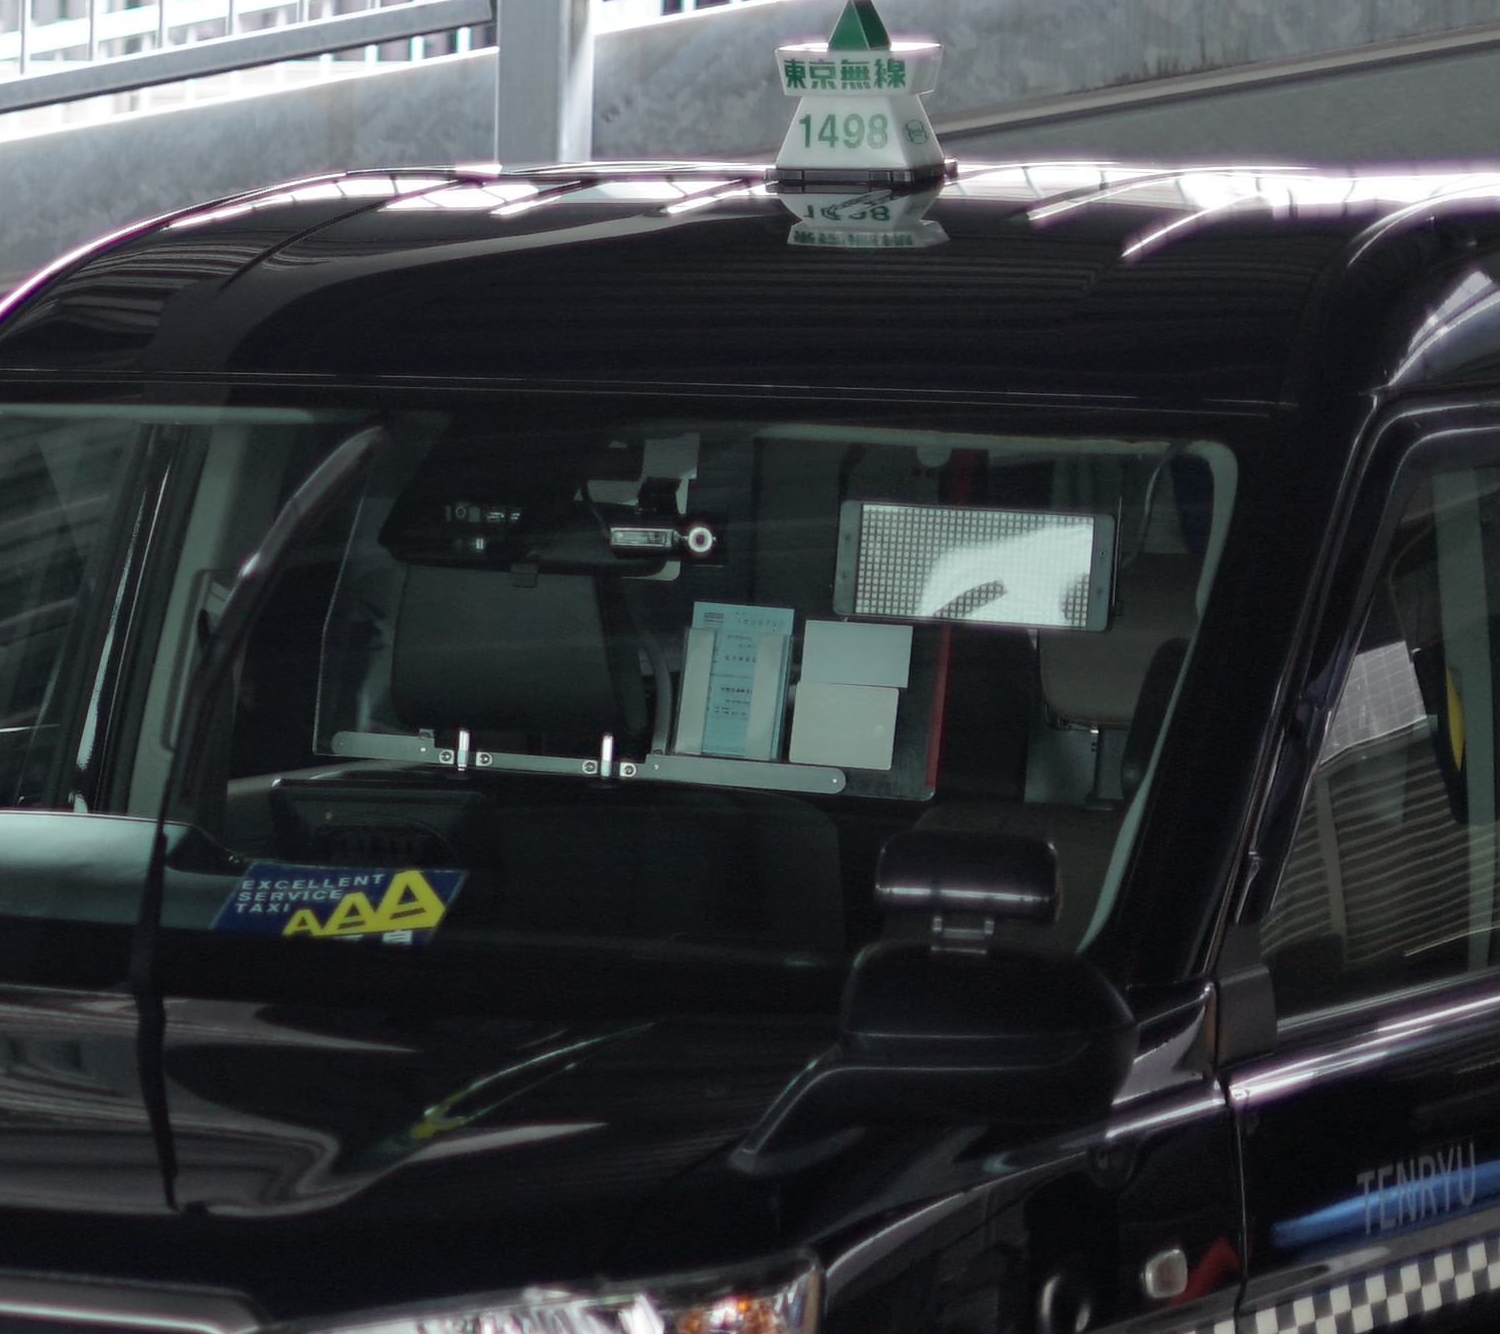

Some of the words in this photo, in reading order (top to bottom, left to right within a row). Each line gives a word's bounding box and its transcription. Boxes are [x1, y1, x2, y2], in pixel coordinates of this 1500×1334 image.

[784, 58, 906, 90] 東京無線
[798, 113, 889, 150] 1498
[241, 873, 385, 890] EXCELLENT
[237, 889, 343, 902] SERVICE
[234, 903, 290, 914] TAXI
[1356, 1141, 1476, 1236] TENRYU
